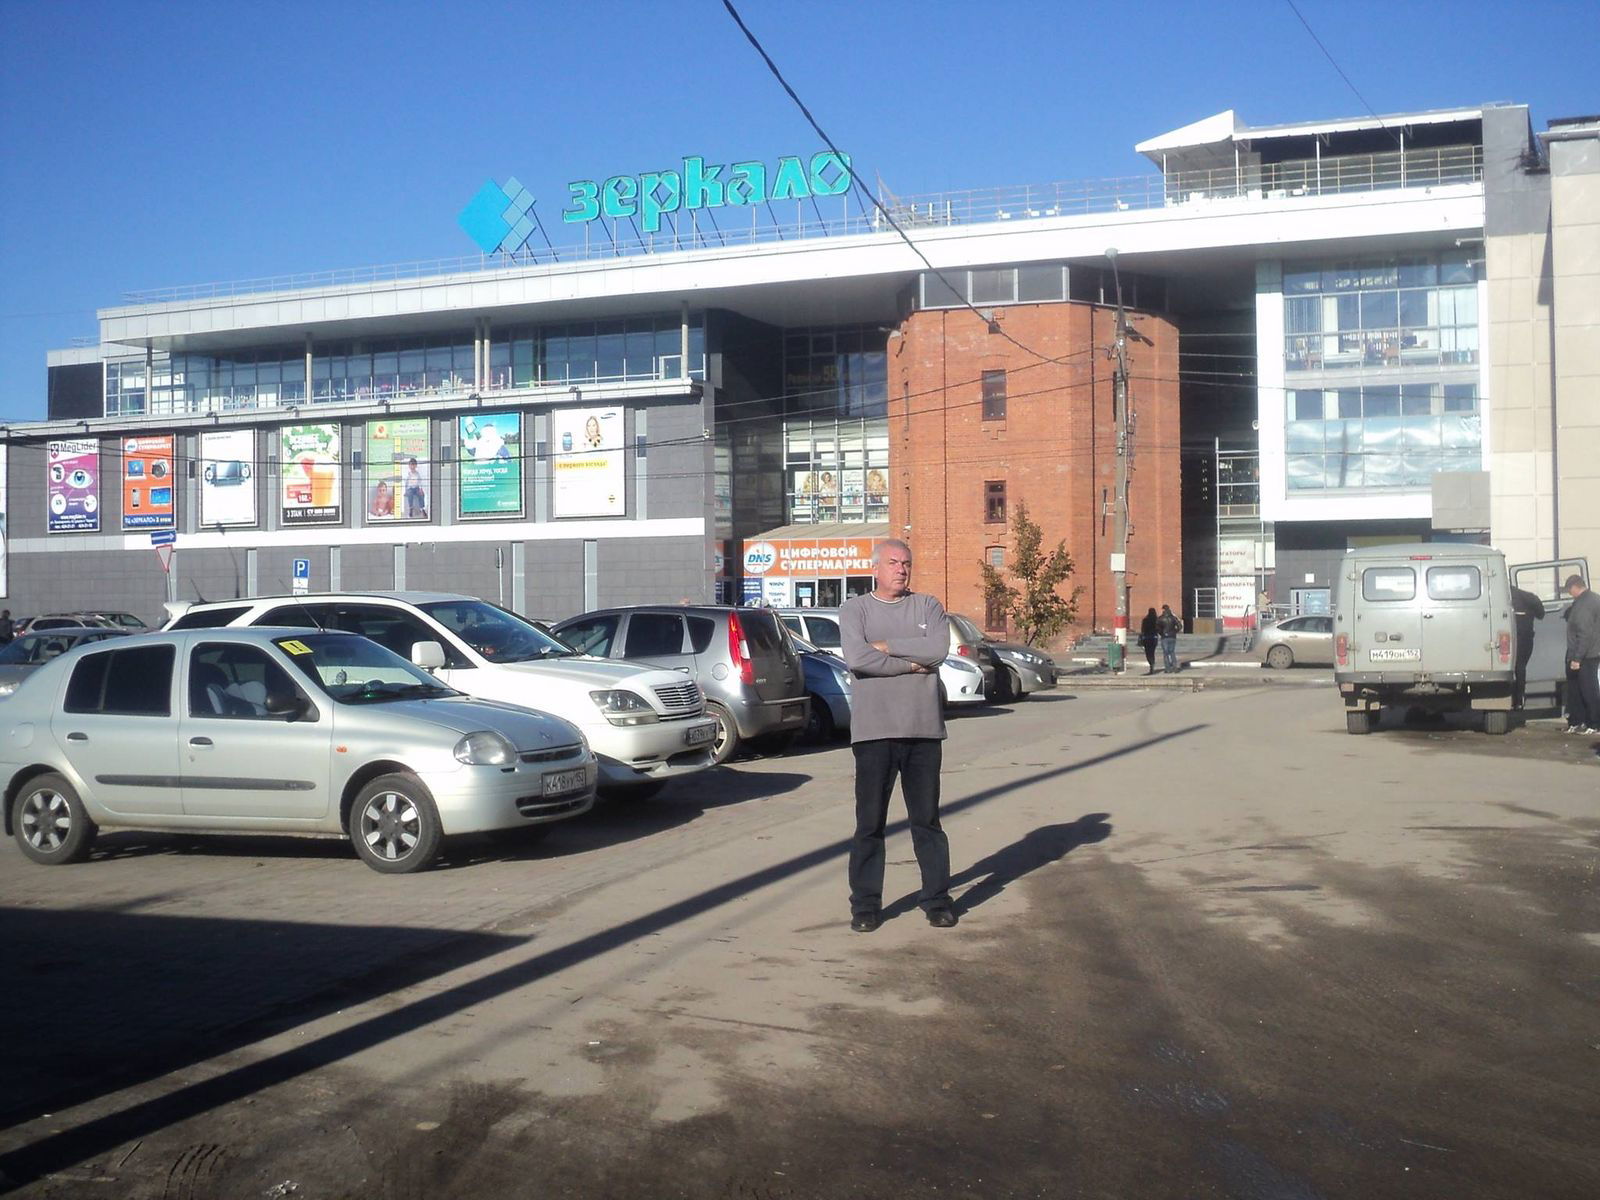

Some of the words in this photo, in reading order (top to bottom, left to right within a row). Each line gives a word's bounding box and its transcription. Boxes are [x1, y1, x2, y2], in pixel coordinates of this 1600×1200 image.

[748, 554, 772, 563] DNS
[779, 545, 858, 559] ЦИФРОВОЙ
[297, 561, 306, 577] P
